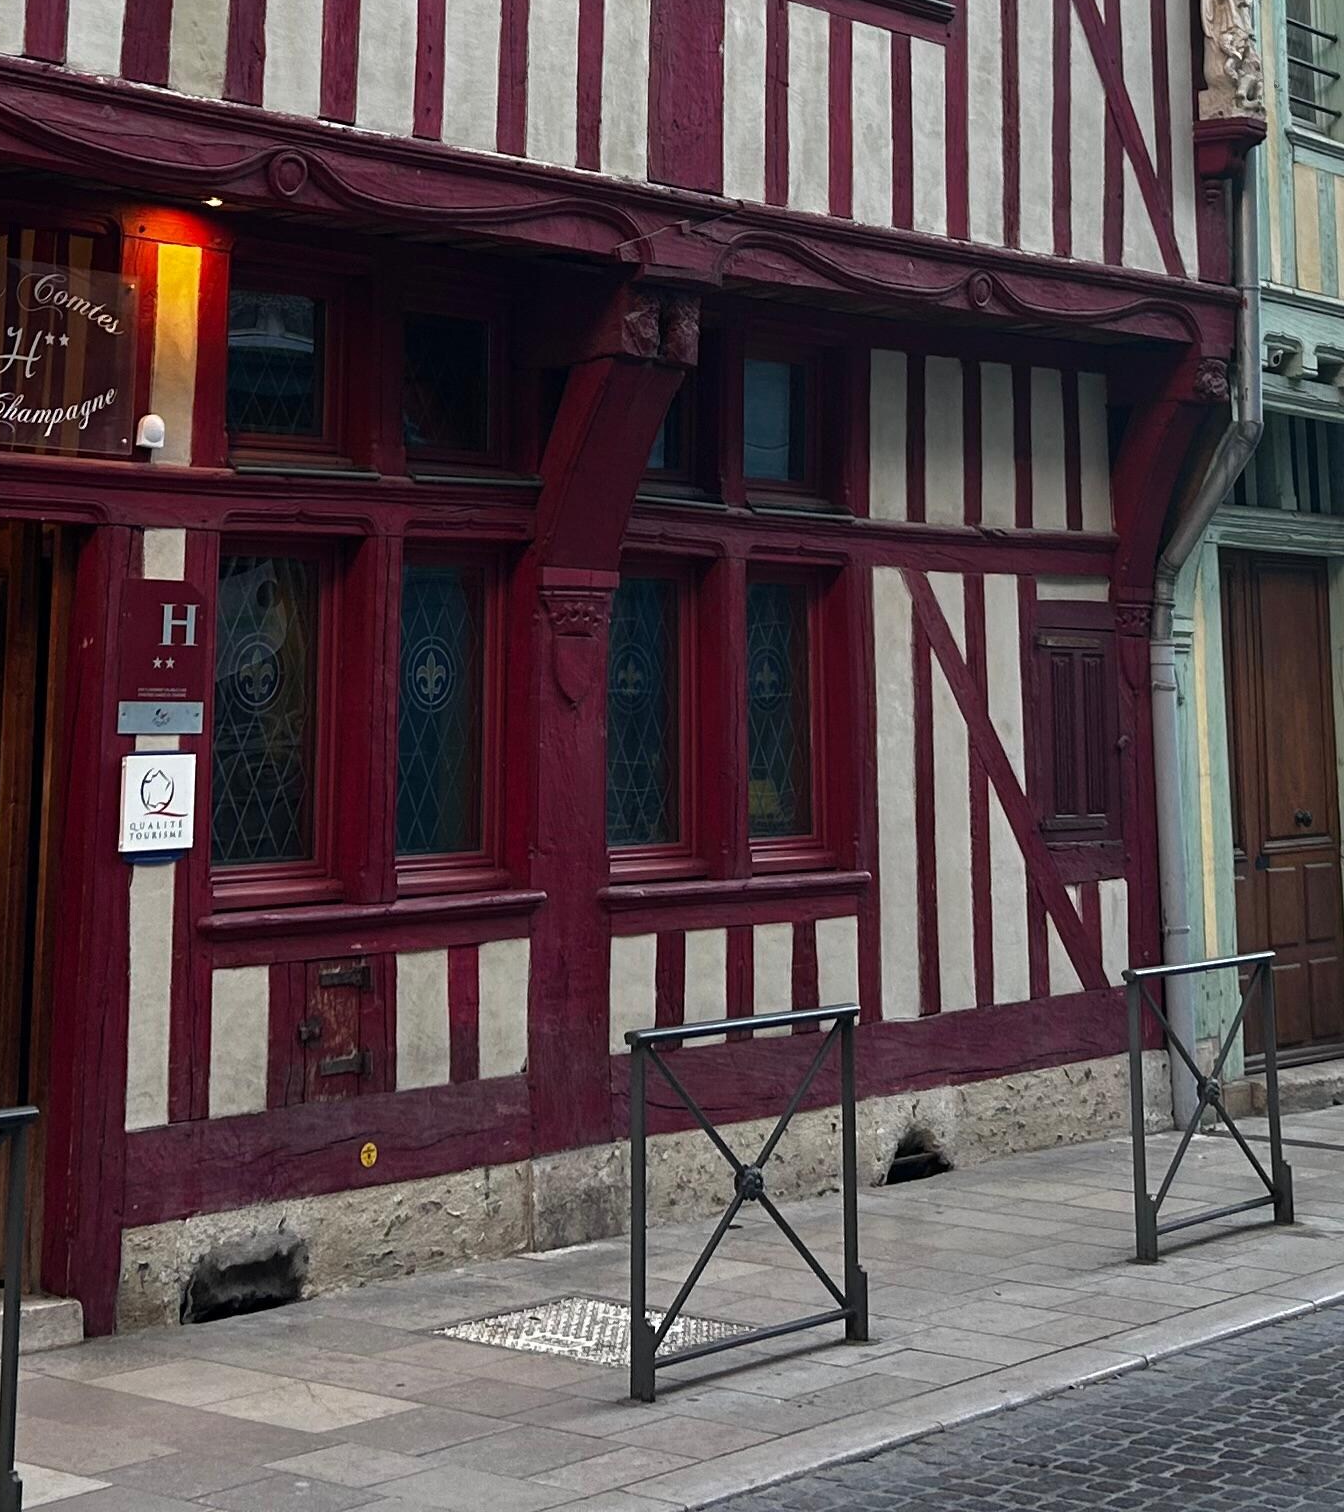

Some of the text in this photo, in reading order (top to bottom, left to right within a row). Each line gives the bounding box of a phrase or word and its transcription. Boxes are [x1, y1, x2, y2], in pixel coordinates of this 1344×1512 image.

[16, 273, 124, 335] Comtes
[158, 603, 201, 647] H
[129, 830, 183, 841] TOURISME
